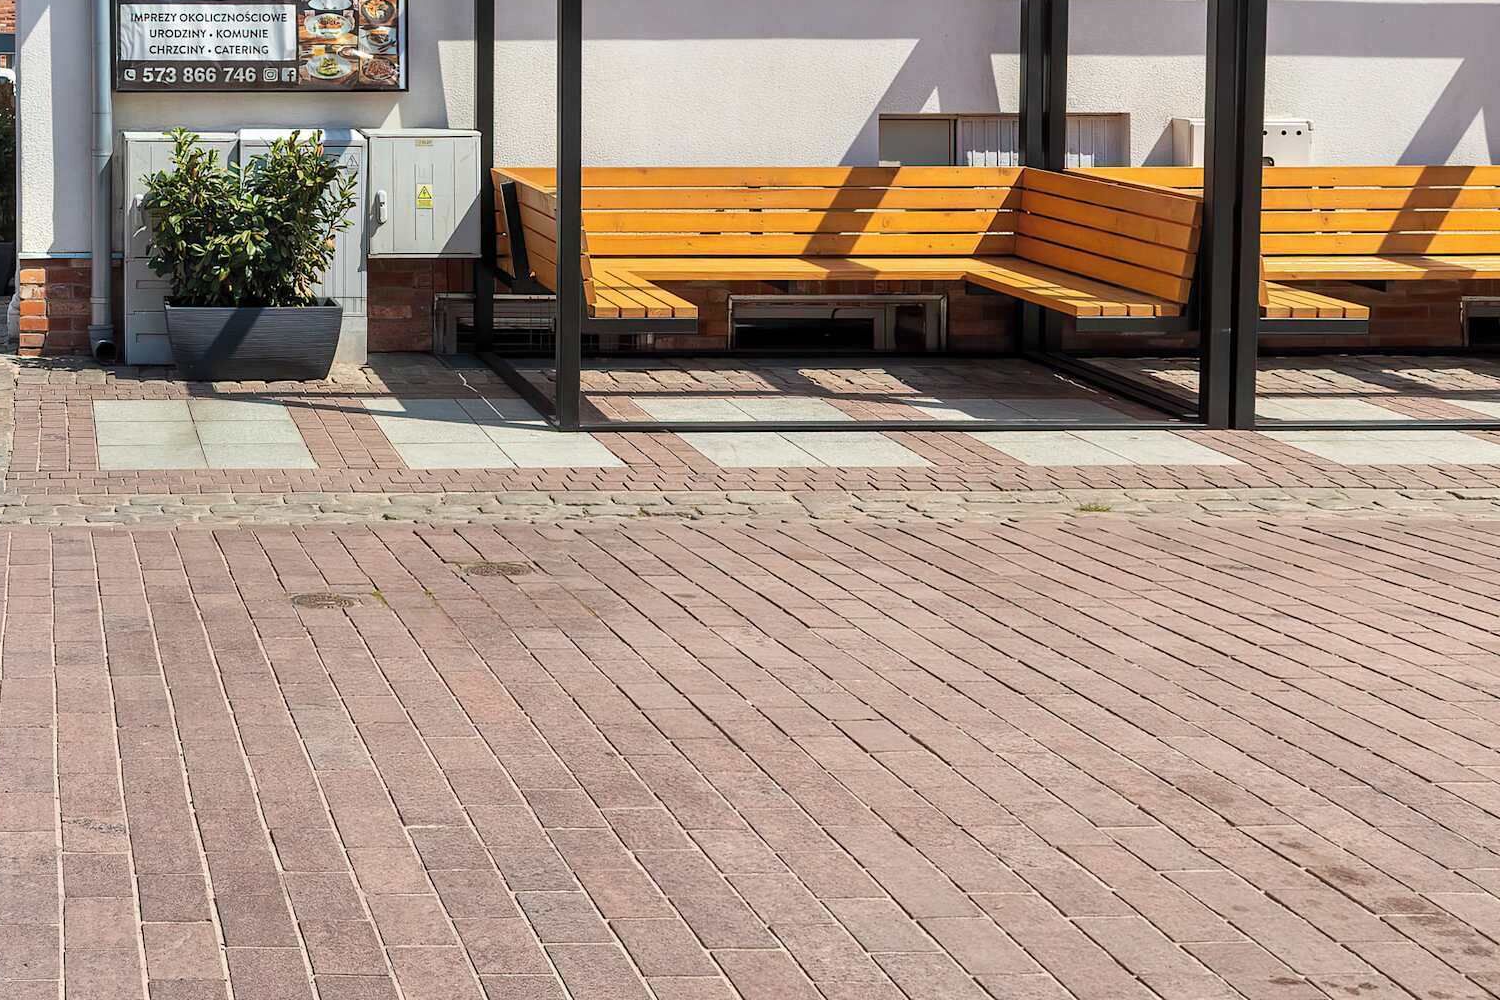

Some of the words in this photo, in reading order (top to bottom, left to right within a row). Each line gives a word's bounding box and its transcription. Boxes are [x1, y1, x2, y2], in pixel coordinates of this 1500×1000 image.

[130, 13, 177, 23] IMPREZY
[179, 10, 288, 23] OKOLICZNOŚCIOWE
[149, 29, 207, 39] URODZINY
[216, 29, 269, 39] KOMUNIE
[149, 45, 205, 55] CHRZCINY
[214, 45, 269, 55] CATERING
[142, 67, 177, 83] 573
[183, 67, 217, 83] 866
[223, 67, 257, 83] 746
